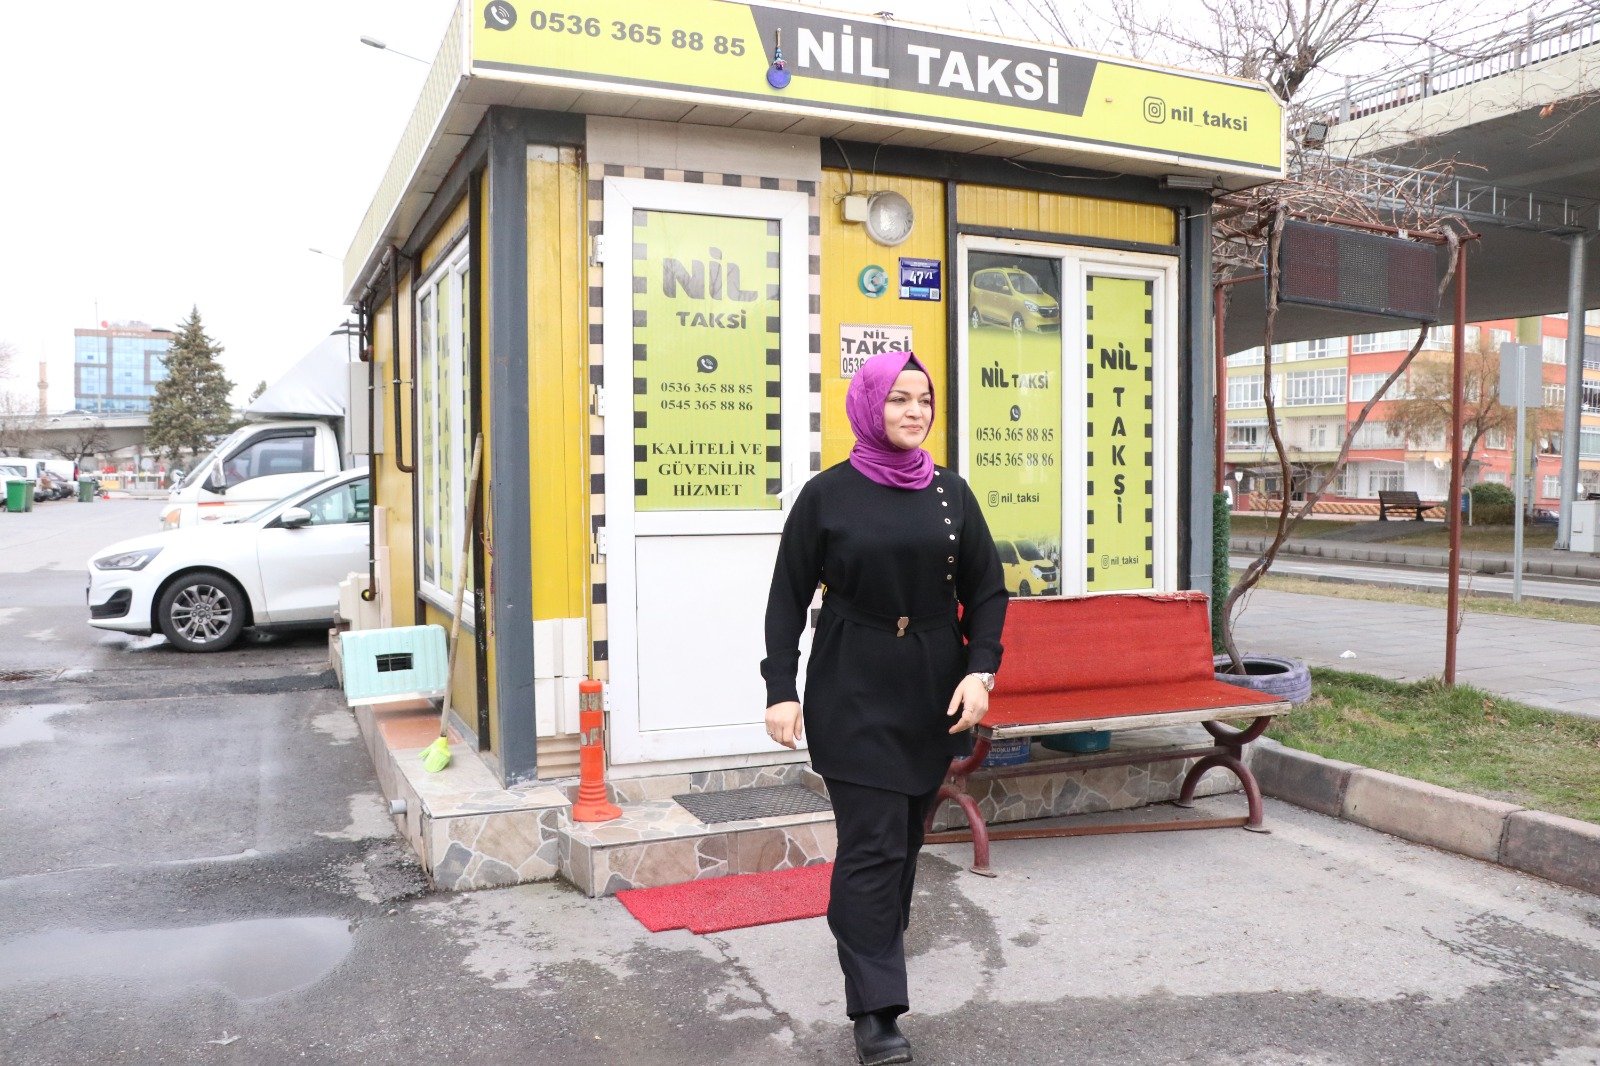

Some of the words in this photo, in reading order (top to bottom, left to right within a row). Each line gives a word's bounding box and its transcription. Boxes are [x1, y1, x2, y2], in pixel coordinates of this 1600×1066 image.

[530, 10, 601, 38] 0536
[611, 20, 662, 46] 365
[671, 29, 704, 51] 88
[713, 35, 746, 57] 85
[797, 24, 889, 80] NİL
[907, 44, 1059, 105] TAKSİ
[1171, 105, 1248, 133] nil_taksi
[662, 246, 758, 303] NİL
[676, 309, 747, 330] TAKSİ
[863, 330, 889, 339] NİL
[842, 336, 909, 354] TAKSİ
[1100, 342, 1138, 371] NİL
[982, 361, 1009, 388] NİL
[1011, 370, 1049, 389] TAKSİ
[660, 381, 691, 394] 0536
[694, 382, 717, 394] 365
[720, 383, 735, 395] 88
[738, 384, 753, 395] 85
[660, 400, 691, 411] 0545
[694, 400, 717, 411] 365
[720, 401, 735, 411] 88
[738, 401, 753, 412] 86
[976, 427, 1002, 441] 0536
[1004, 427, 1023, 441] 365
[1026, 428, 1039, 442] 88
[1041, 428, 1054, 442] 85
[652, 442, 735, 456] KALİTELİ
[740, 443, 763, 456] VE
[1110, 386, 1127, 524] TAKSİ
[976, 452, 1002, 467] 0545
[1004, 452, 1023, 467] 365
[1026, 452, 1039, 467] 88
[1041, 452, 1054, 467] 86
[658, 461, 756, 476] GÜVENİLİR
[673, 483, 742, 497] HİZMET
[1001, 493, 1040, 504] nil_taksi
